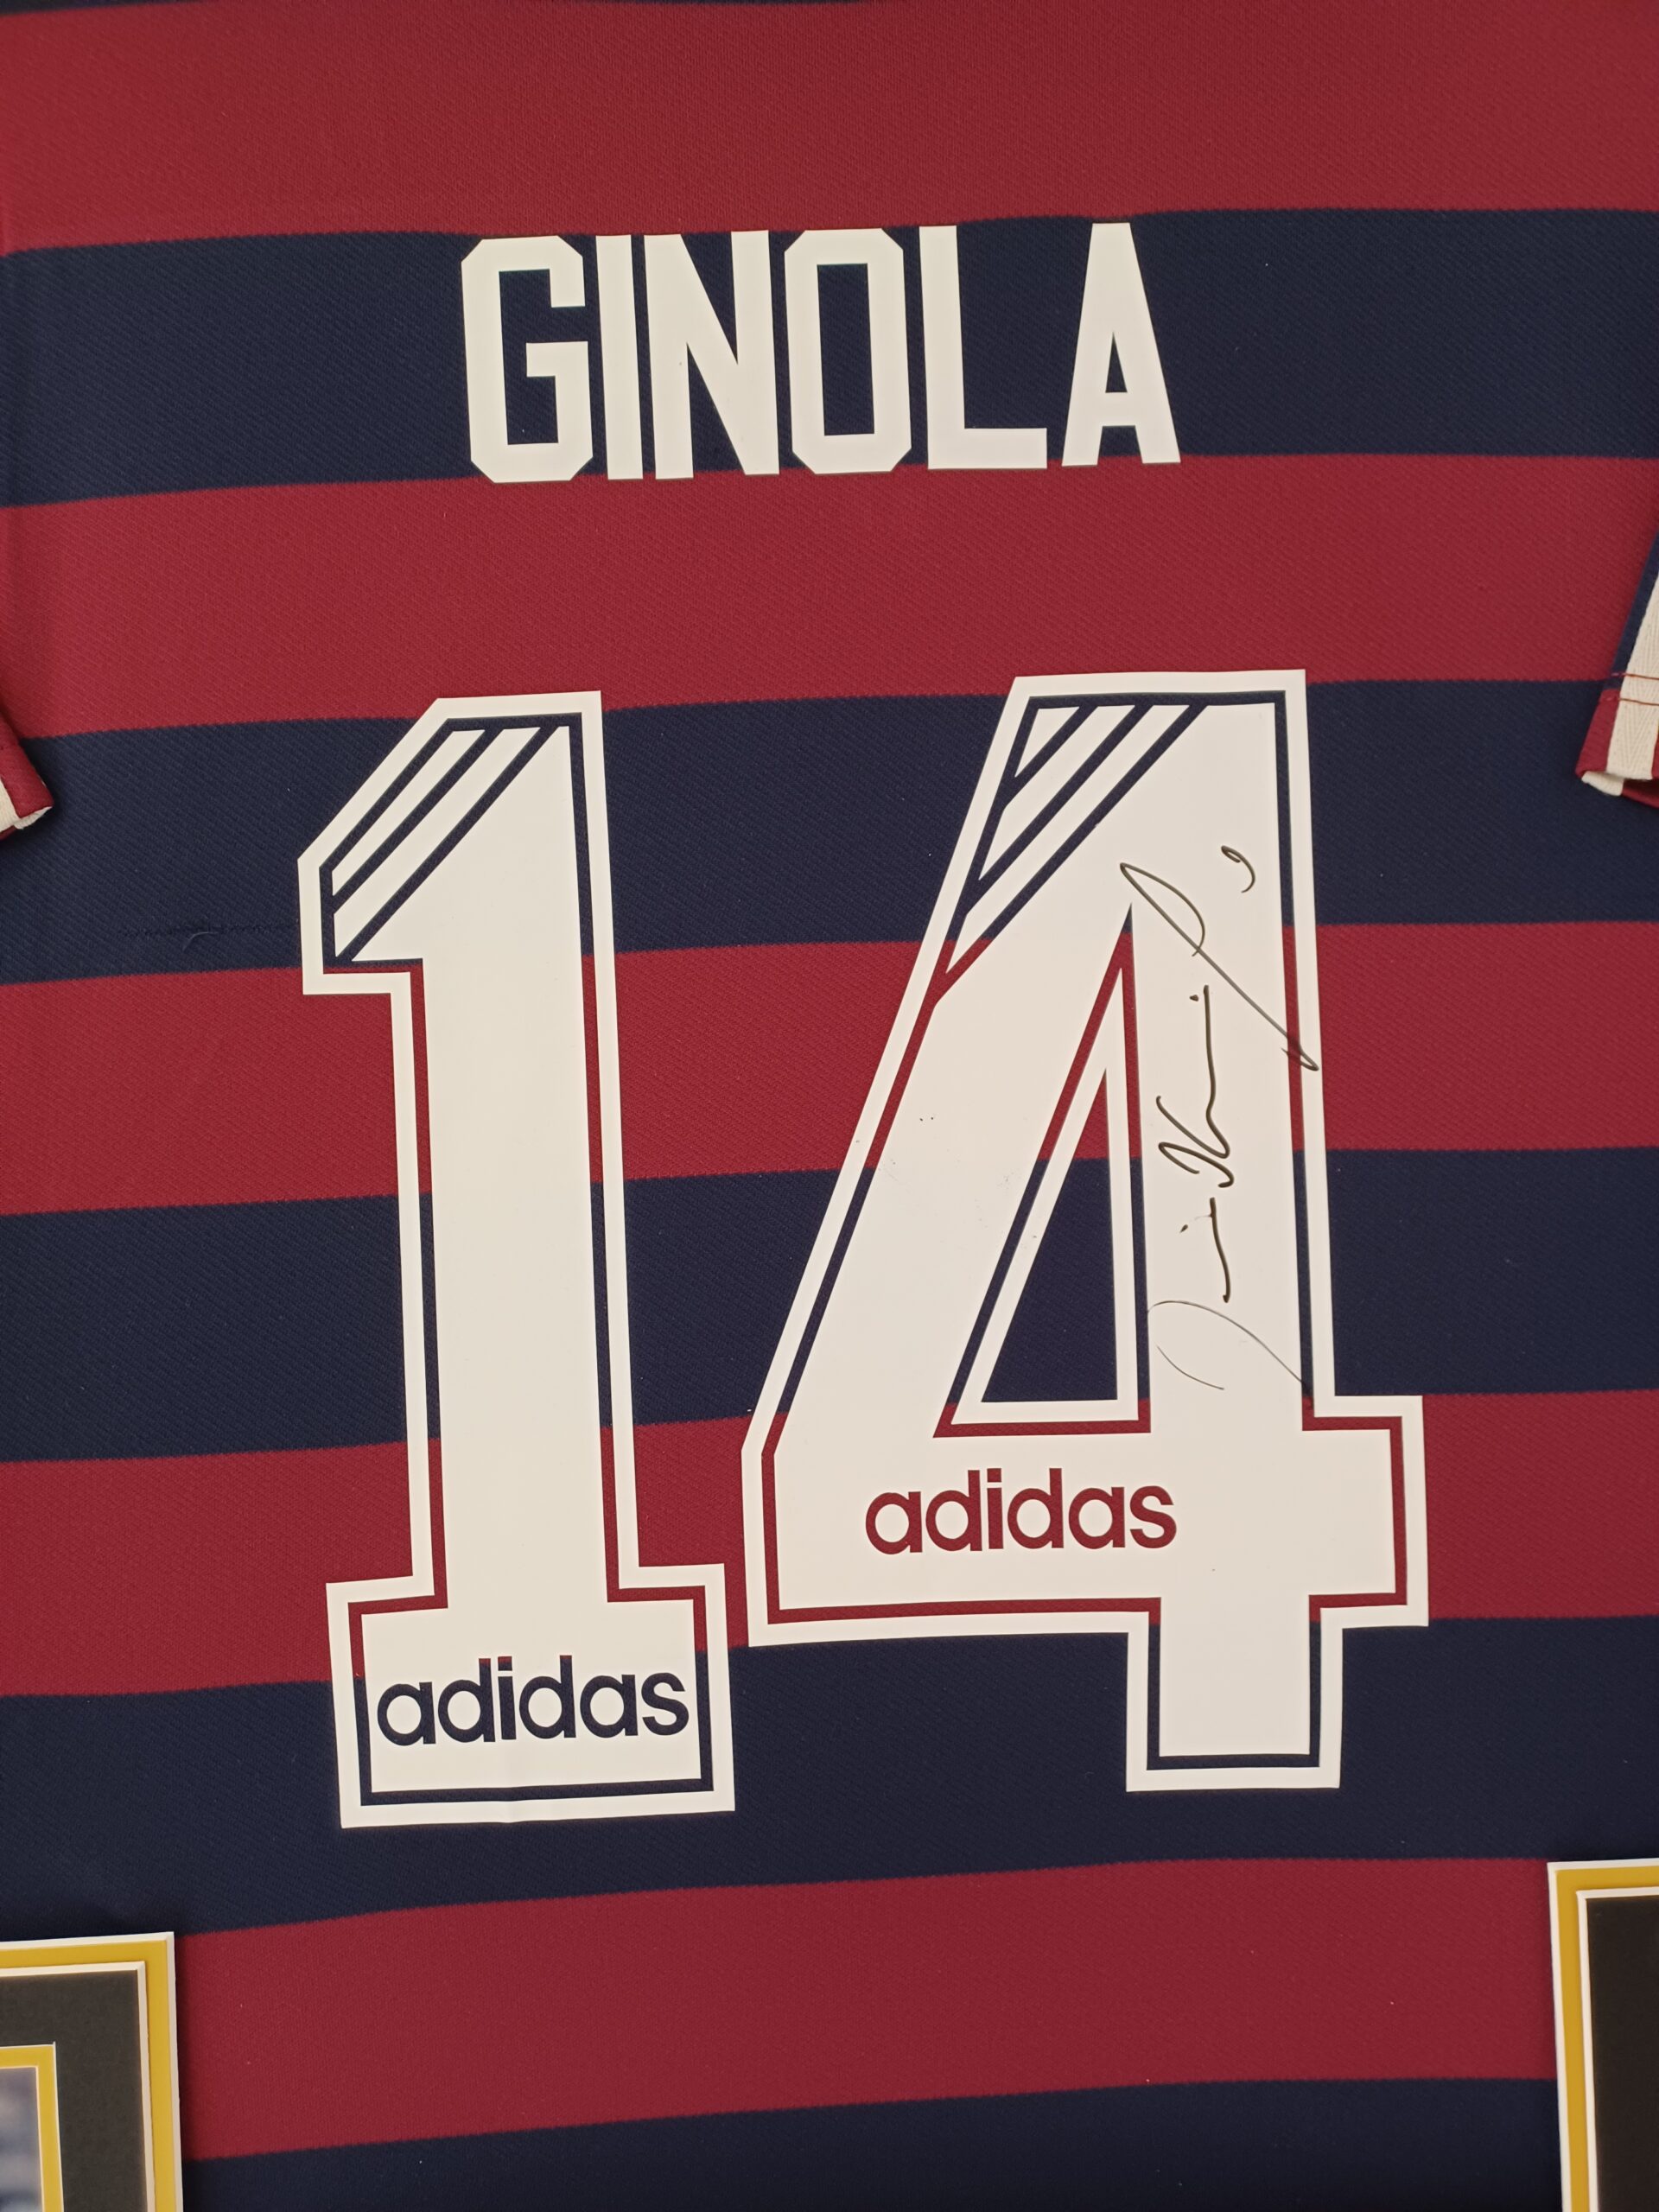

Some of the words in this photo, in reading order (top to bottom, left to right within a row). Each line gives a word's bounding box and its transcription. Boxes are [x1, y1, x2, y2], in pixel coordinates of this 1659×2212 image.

[461, 222, 1181, 483] GINOLA
[296, 669, 1430, 1829] 14
[865, 1468, 1178, 1555] adidas
[377, 1655, 690, 1745] adidas
